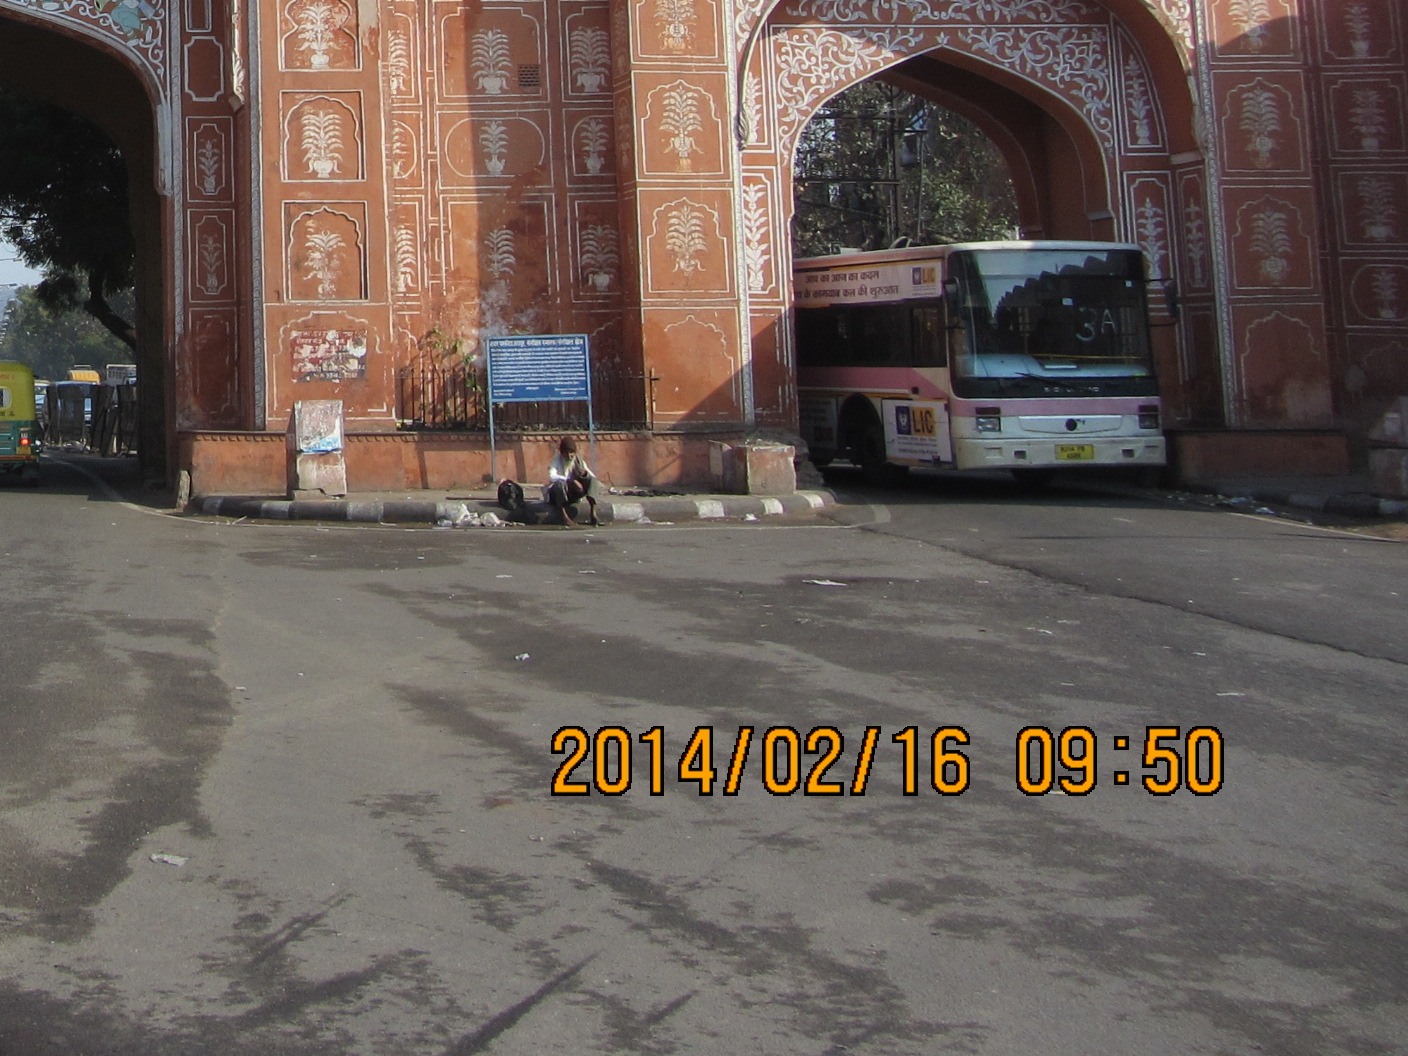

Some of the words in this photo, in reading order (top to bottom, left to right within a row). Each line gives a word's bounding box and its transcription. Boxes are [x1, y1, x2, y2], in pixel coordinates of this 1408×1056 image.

[820, 274, 830, 283] का
[831, 273, 847, 283] आज
[848, 272, 858, 282] का
[860, 270, 879, 280] कदम
[803, 288, 812, 298] के
[813, 288, 840, 299] कामयाब
[842, 287, 856, 297] कल
[858, 284, 868, 296] की
[869, 285, 899, 298] शुरुआत
[912, 409, 934, 434] LIC
